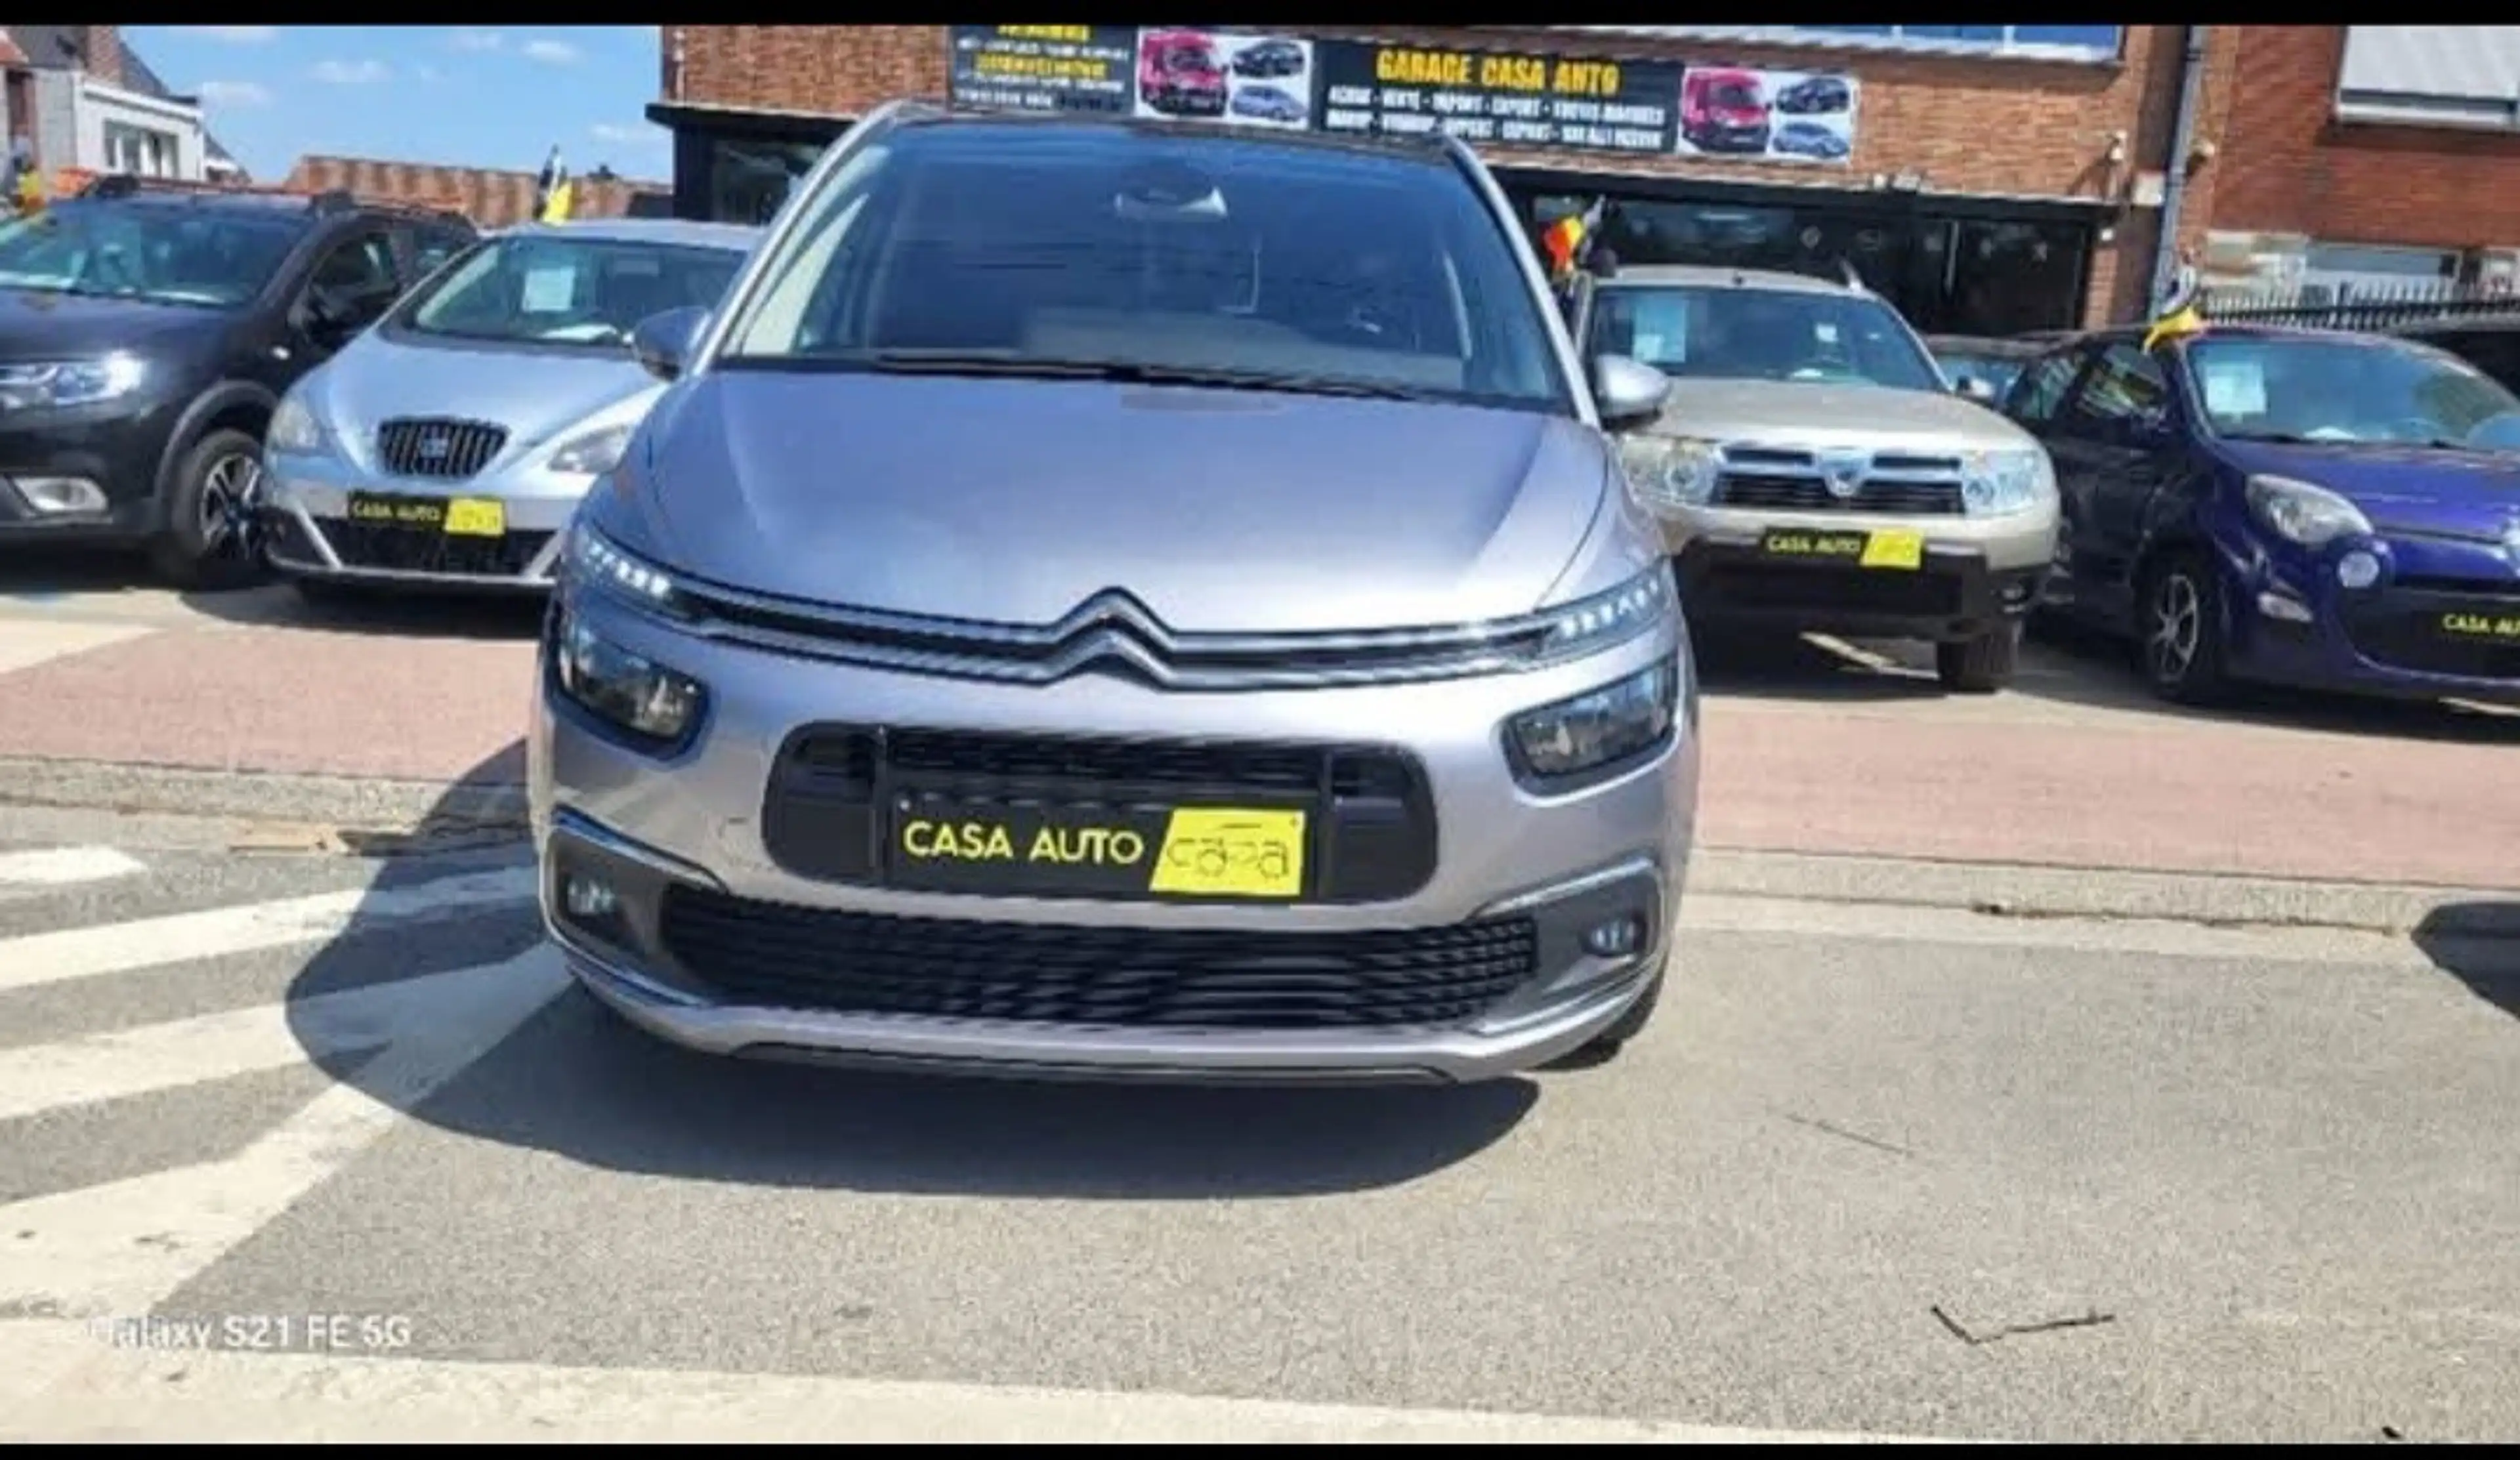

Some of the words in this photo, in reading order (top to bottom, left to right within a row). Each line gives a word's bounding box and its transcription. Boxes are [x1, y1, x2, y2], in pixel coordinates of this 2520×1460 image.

[1376, 49, 1472, 83] GARAGE
[1480, 56, 1545, 90] CASA
[353, 501, 393, 518] CASA
[396, 505, 440, 522] AUTO
[1768, 535, 1811, 552] CASA
[2442, 613, 2490, 634] CASA
[903, 820, 1015, 860] CASA
[1028, 827, 1144, 865] AUTO
